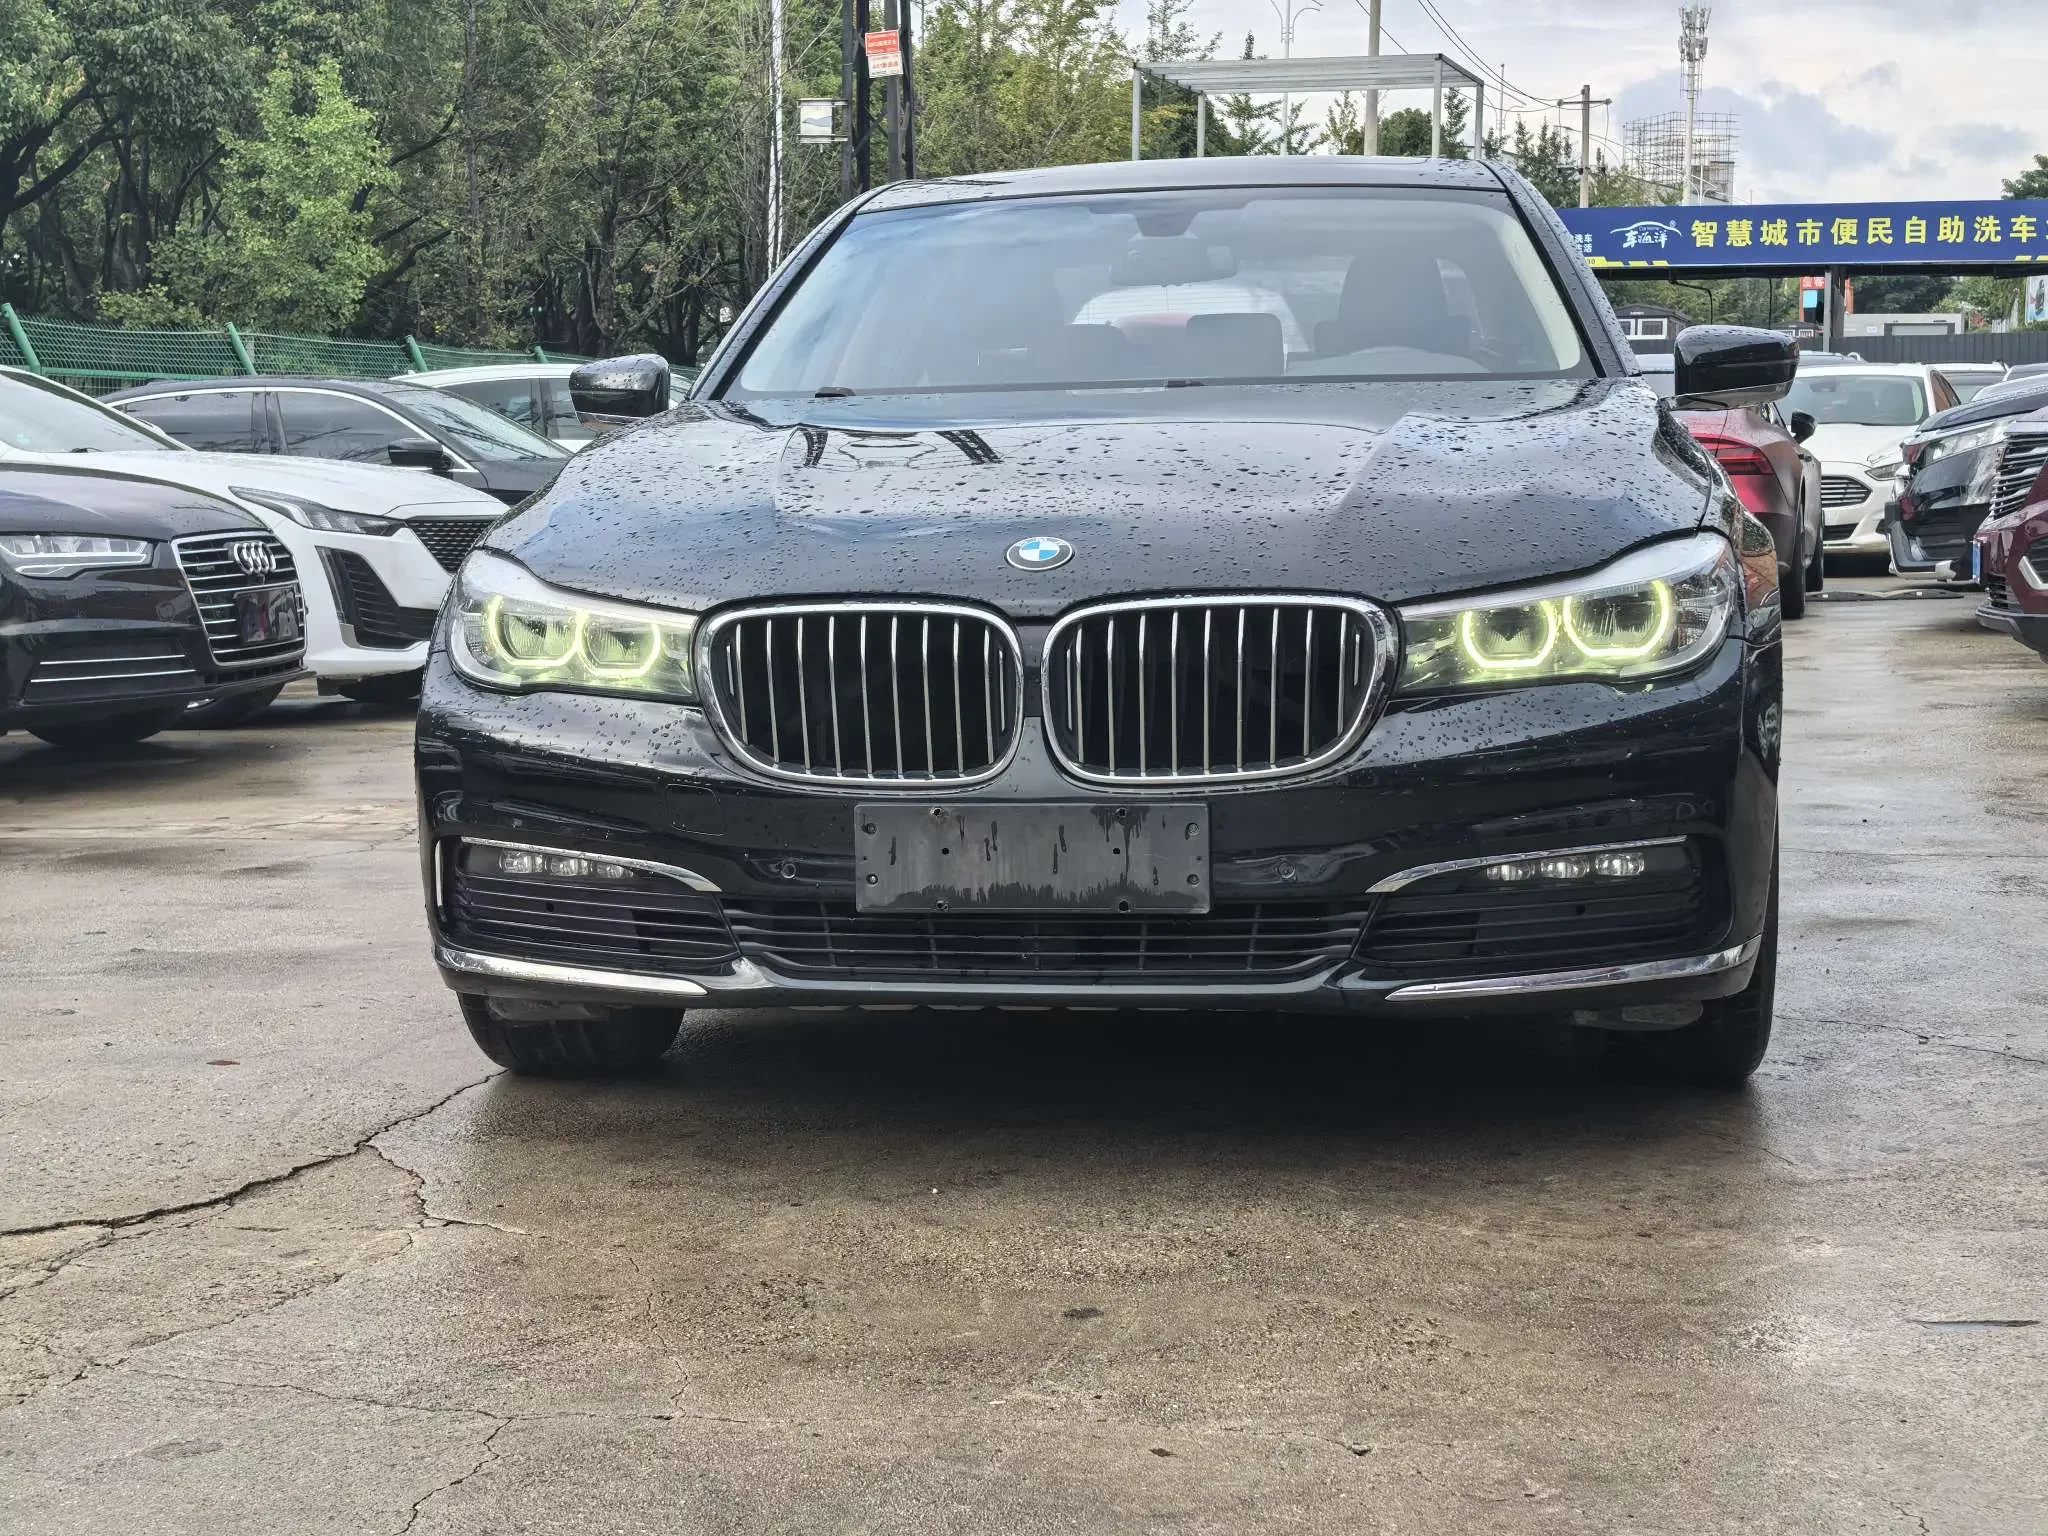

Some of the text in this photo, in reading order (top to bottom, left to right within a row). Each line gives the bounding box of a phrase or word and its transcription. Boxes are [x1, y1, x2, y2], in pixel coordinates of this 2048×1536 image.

[1691, 215, 2048, 248] 智慧城市便民自助洗车
